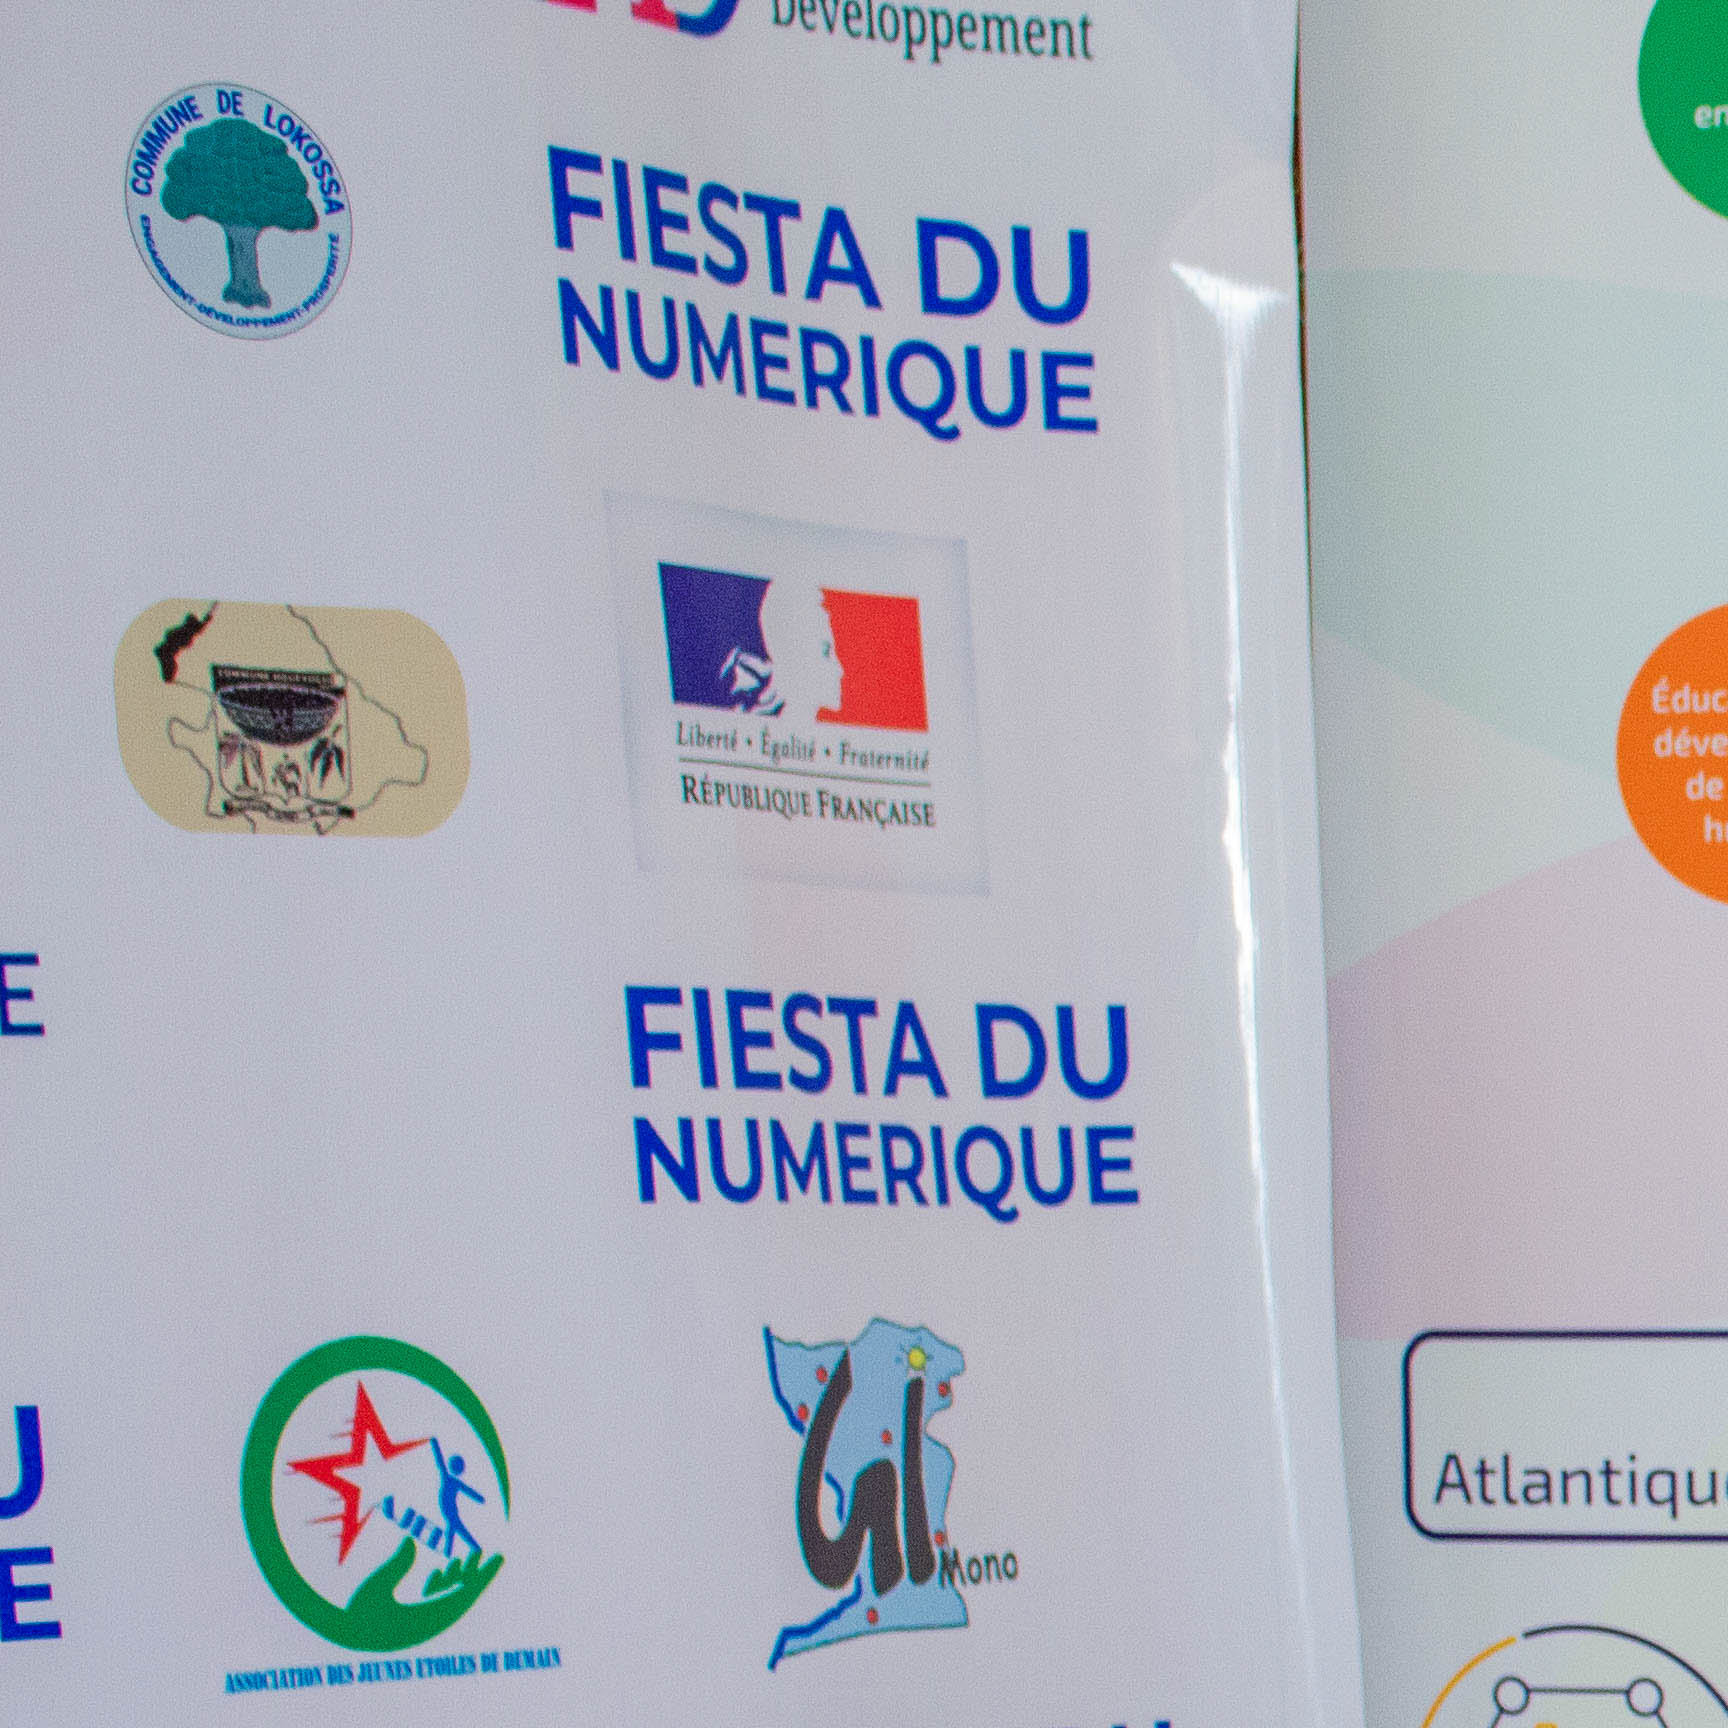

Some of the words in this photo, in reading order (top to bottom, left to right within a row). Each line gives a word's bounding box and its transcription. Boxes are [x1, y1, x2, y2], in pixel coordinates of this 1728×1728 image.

[131, 95, 204, 197] COMMUNE
[216, 88, 244, 116] DE
[263, 103, 346, 217] LOKOSSA
[547, 144, 884, 312] FIESTA
[915, 216, 1092, 326] DU
[556, 276, 1100, 442] NUMERIQUE
[675, 719, 738, 752] Liberté
[839, 740, 930, 772] Fraternité
[1685, 770, 1725, 802] de
[623, 984, 949, 1099] FIESTA
[973, 1002, 1132, 1101] DU
[631, 1114, 1141, 1225] NUMERIQUE
